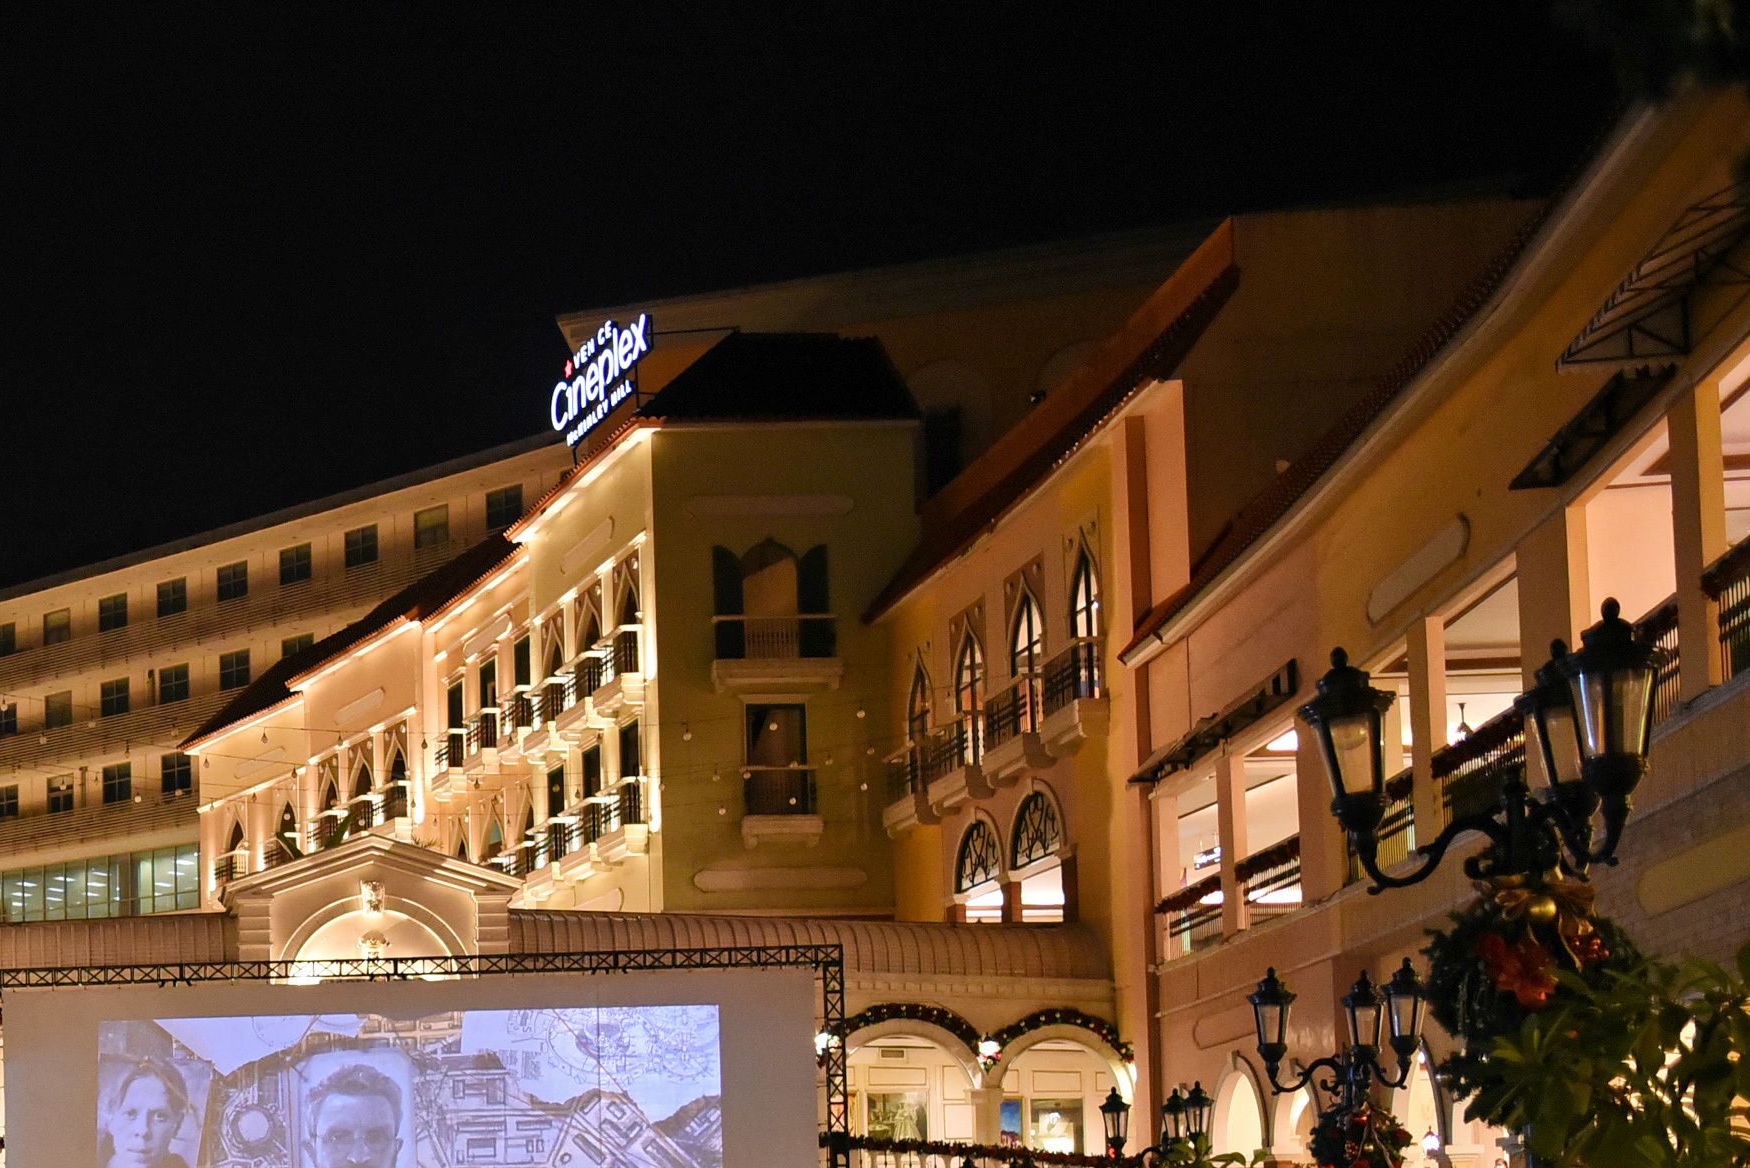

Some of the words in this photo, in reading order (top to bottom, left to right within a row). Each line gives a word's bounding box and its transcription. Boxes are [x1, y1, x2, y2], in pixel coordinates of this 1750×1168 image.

[572, 319, 614, 370] VENCE
[550, 312, 649, 432] Cineplex
[610, 379, 633, 407] HILL
